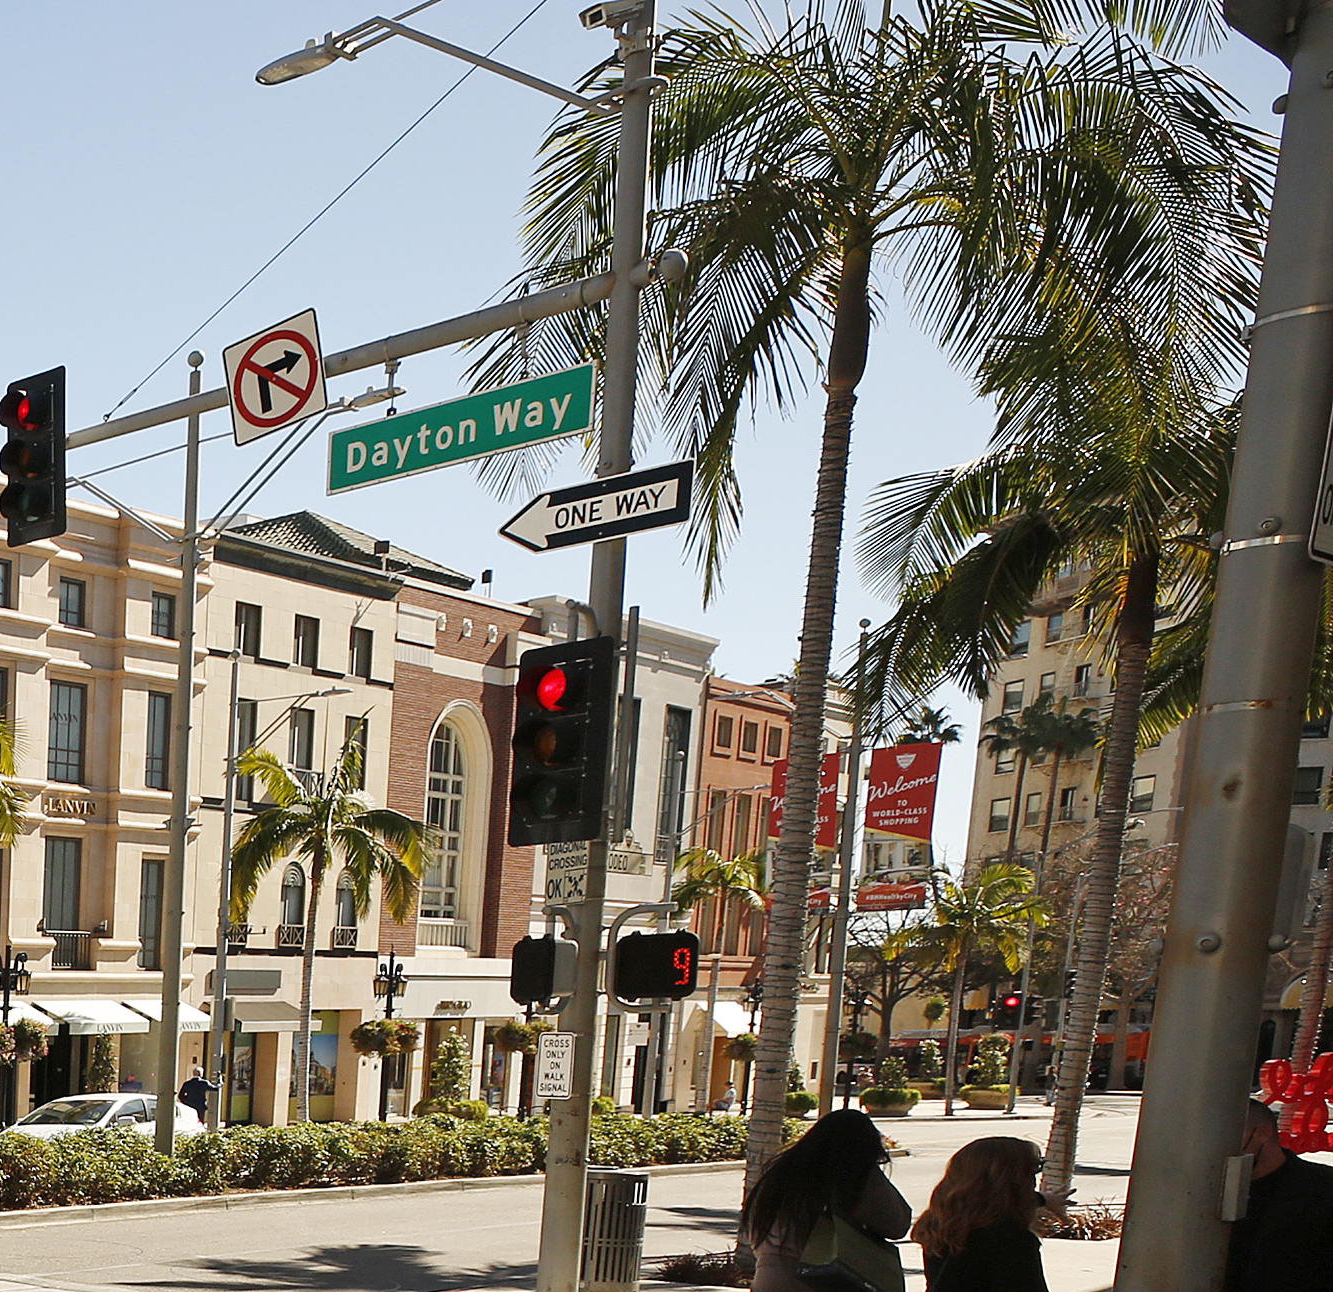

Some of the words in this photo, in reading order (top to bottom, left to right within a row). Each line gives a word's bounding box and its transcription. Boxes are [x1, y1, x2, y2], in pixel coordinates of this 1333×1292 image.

[345, 417, 478, 474] Dayton
[494, 392, 573, 437] Way
[554, 497, 604, 531] ONE
[614, 484, 668, 516] WAY
[868, 773, 938, 802] Welcome
[48, 797, 97, 815] LANVIN
[872, 807, 928, 818] WORLD-CLASS
[878, 817, 920, 827] SHOPPING
[549, 840, 588, 856] DIAGONAL
[548, 853, 588, 871] CROSSING
[608, 853, 629, 871] ODEO
[546, 878, 563, 899] OK
[673, 947, 692, 985] 9
[96, 1023, 123, 1032] LANVIN
[179, 1022, 202, 1031] ANVIN
[543, 1039, 570, 1048] CROSS
[546, 1050, 566, 1059] ONLY
[549, 1061, 561, 1070] ON
[543, 1072, 565, 1081] WALK
[539, 1082, 568, 1092] SIGNAL
